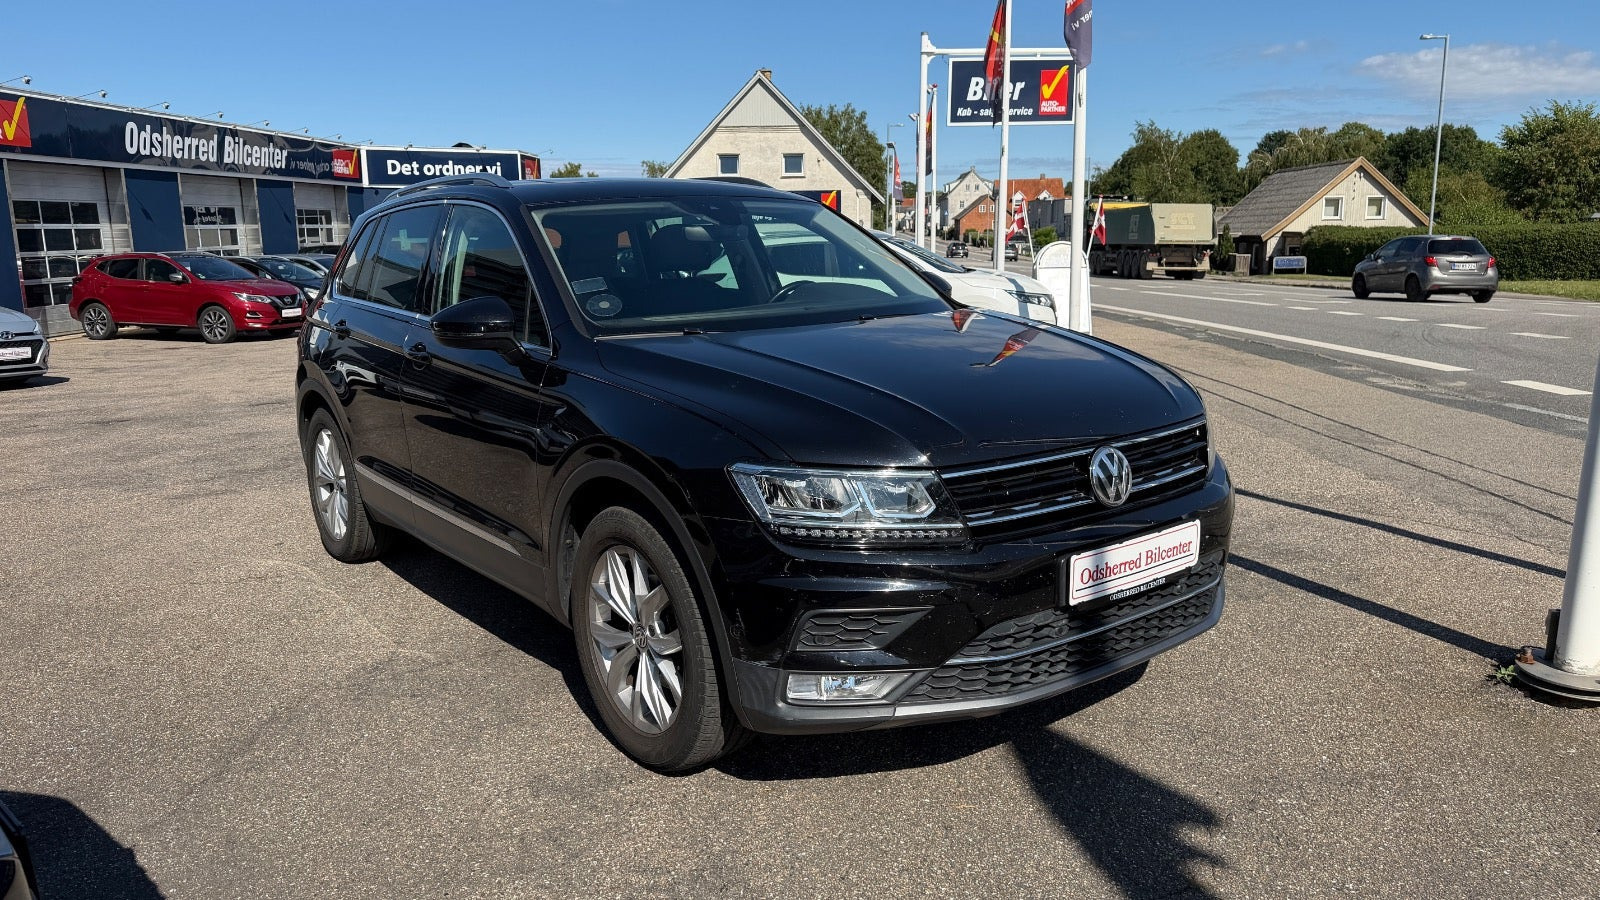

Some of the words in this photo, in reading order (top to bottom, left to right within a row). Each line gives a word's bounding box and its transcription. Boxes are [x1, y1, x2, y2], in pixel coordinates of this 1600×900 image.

[966, 76, 1026, 101] Ber
[1008, 106, 1034, 116] ervice
[1040, 105, 1066, 113] PARTNER
[124, 120, 219, 163] Odsherred
[223, 135, 288, 170] Bilcenter
[386, 159, 420, 176] Det
[422, 160, 484, 177] ordner
[485, 161, 502, 177] vi
[1079, 553, 1142, 585] Odsherred
[1144, 540, 1193, 567] Bilcenter
